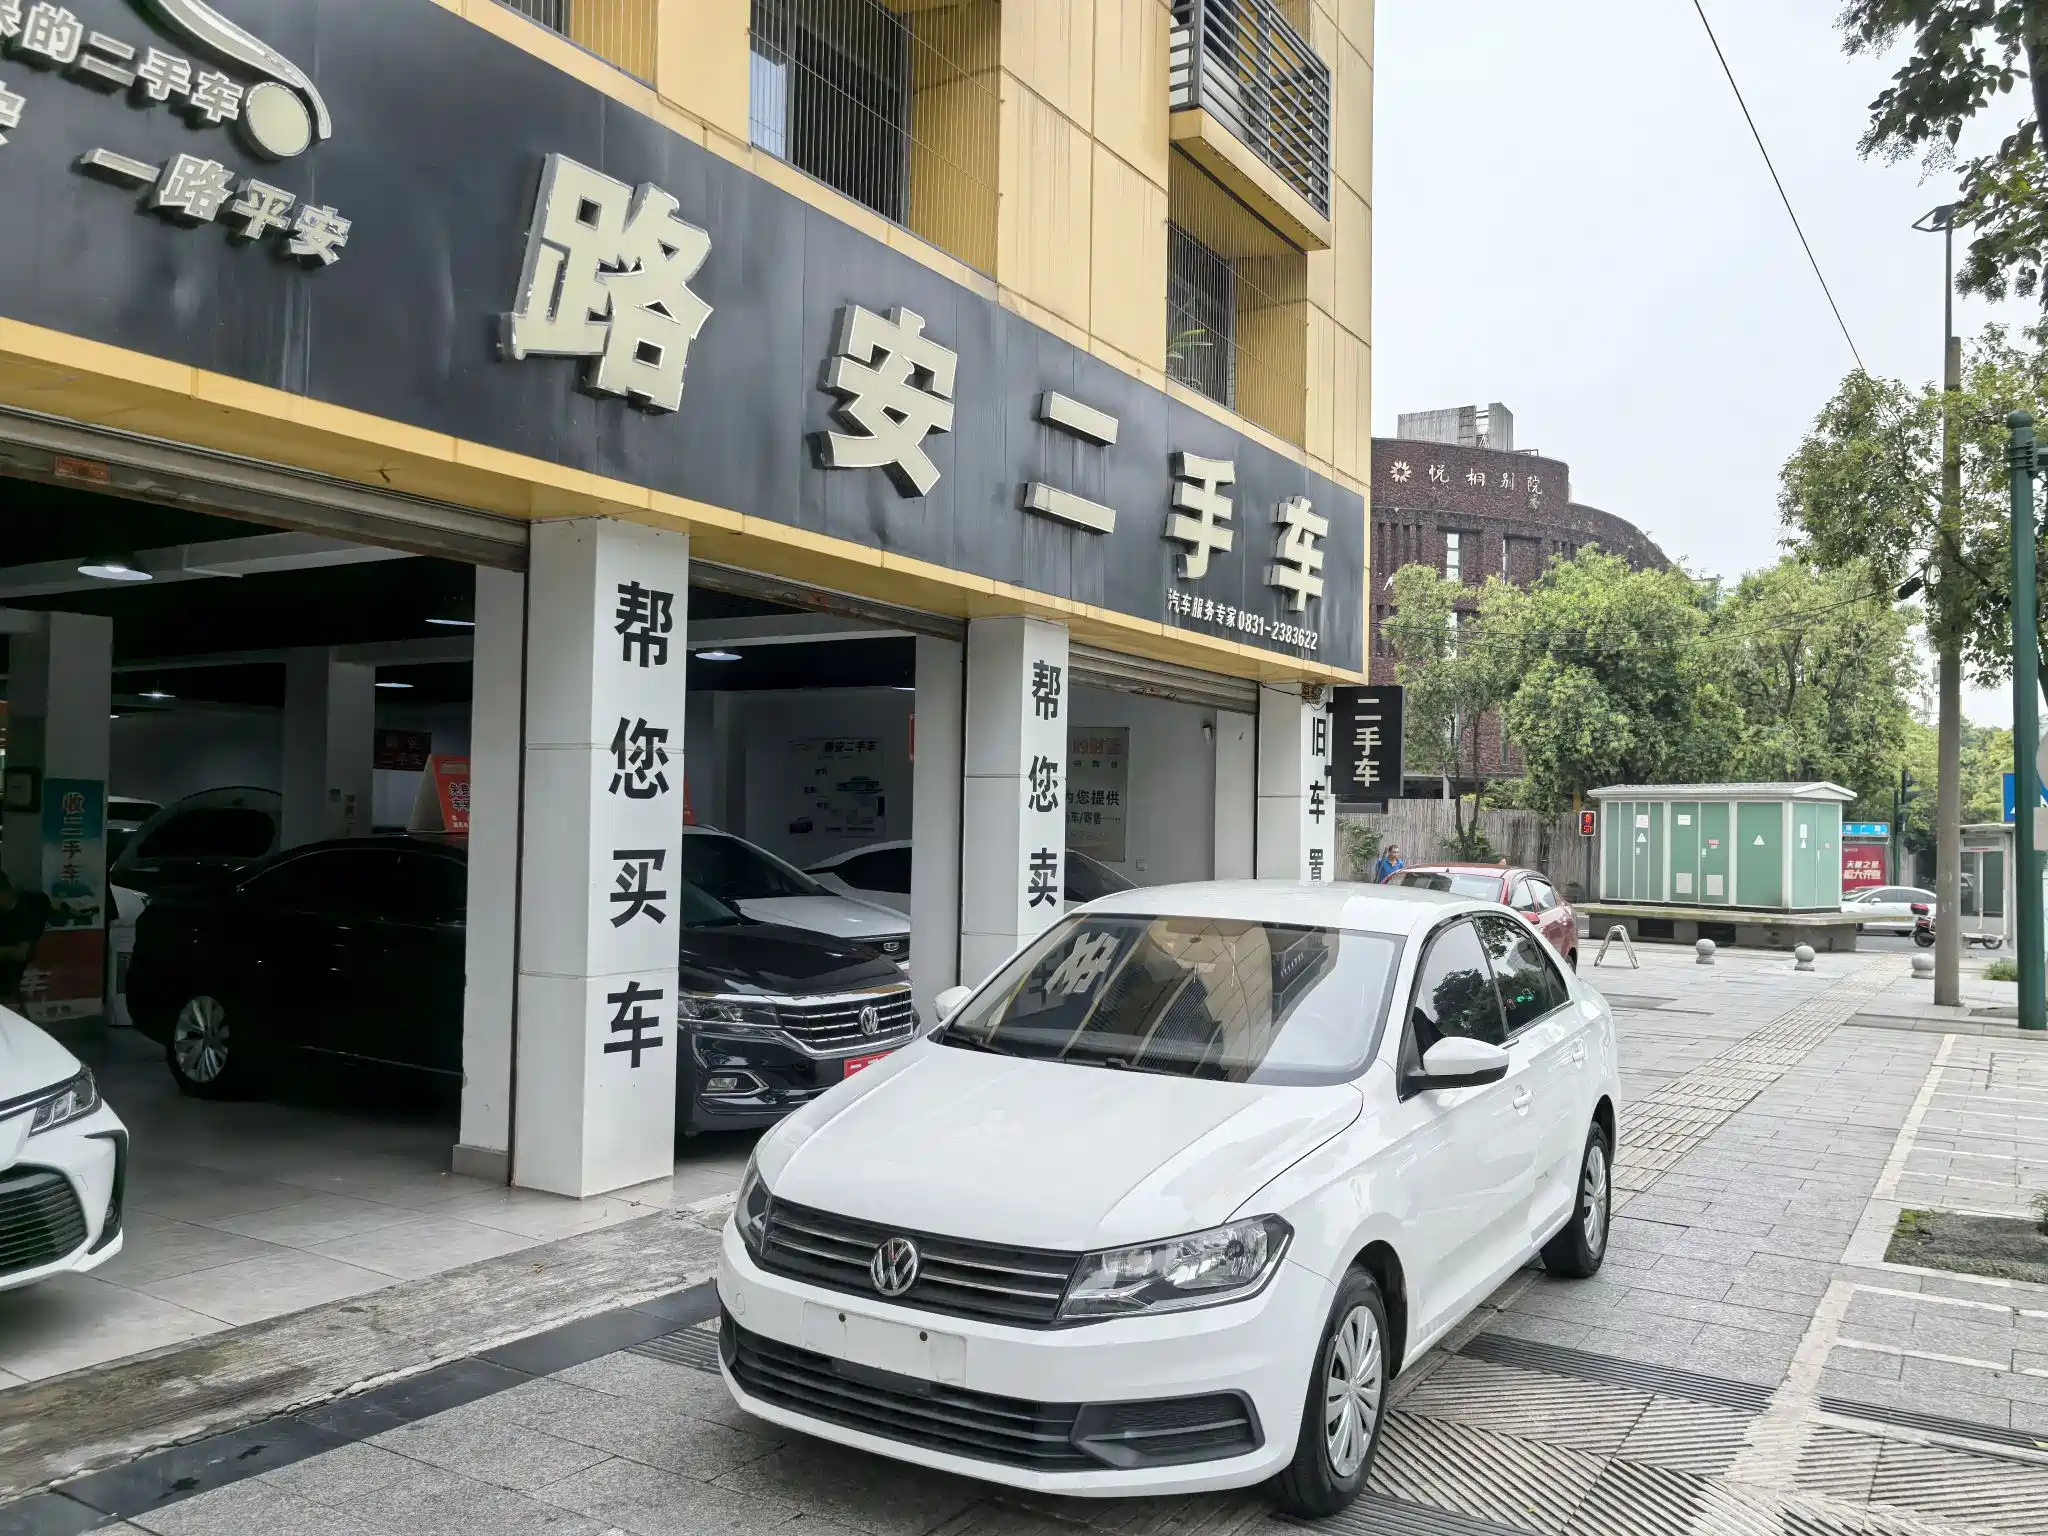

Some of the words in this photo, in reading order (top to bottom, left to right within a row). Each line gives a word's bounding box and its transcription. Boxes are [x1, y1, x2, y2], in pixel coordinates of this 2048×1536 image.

[80, 147, 353, 266] 一路平安
[506, 152, 1330, 612] 路安二手车
[1428, 464, 1543, 496] 悦桐别院
[1352, 698, 1382, 788] 二手车
[603, 581, 674, 1068] 帮您买车
